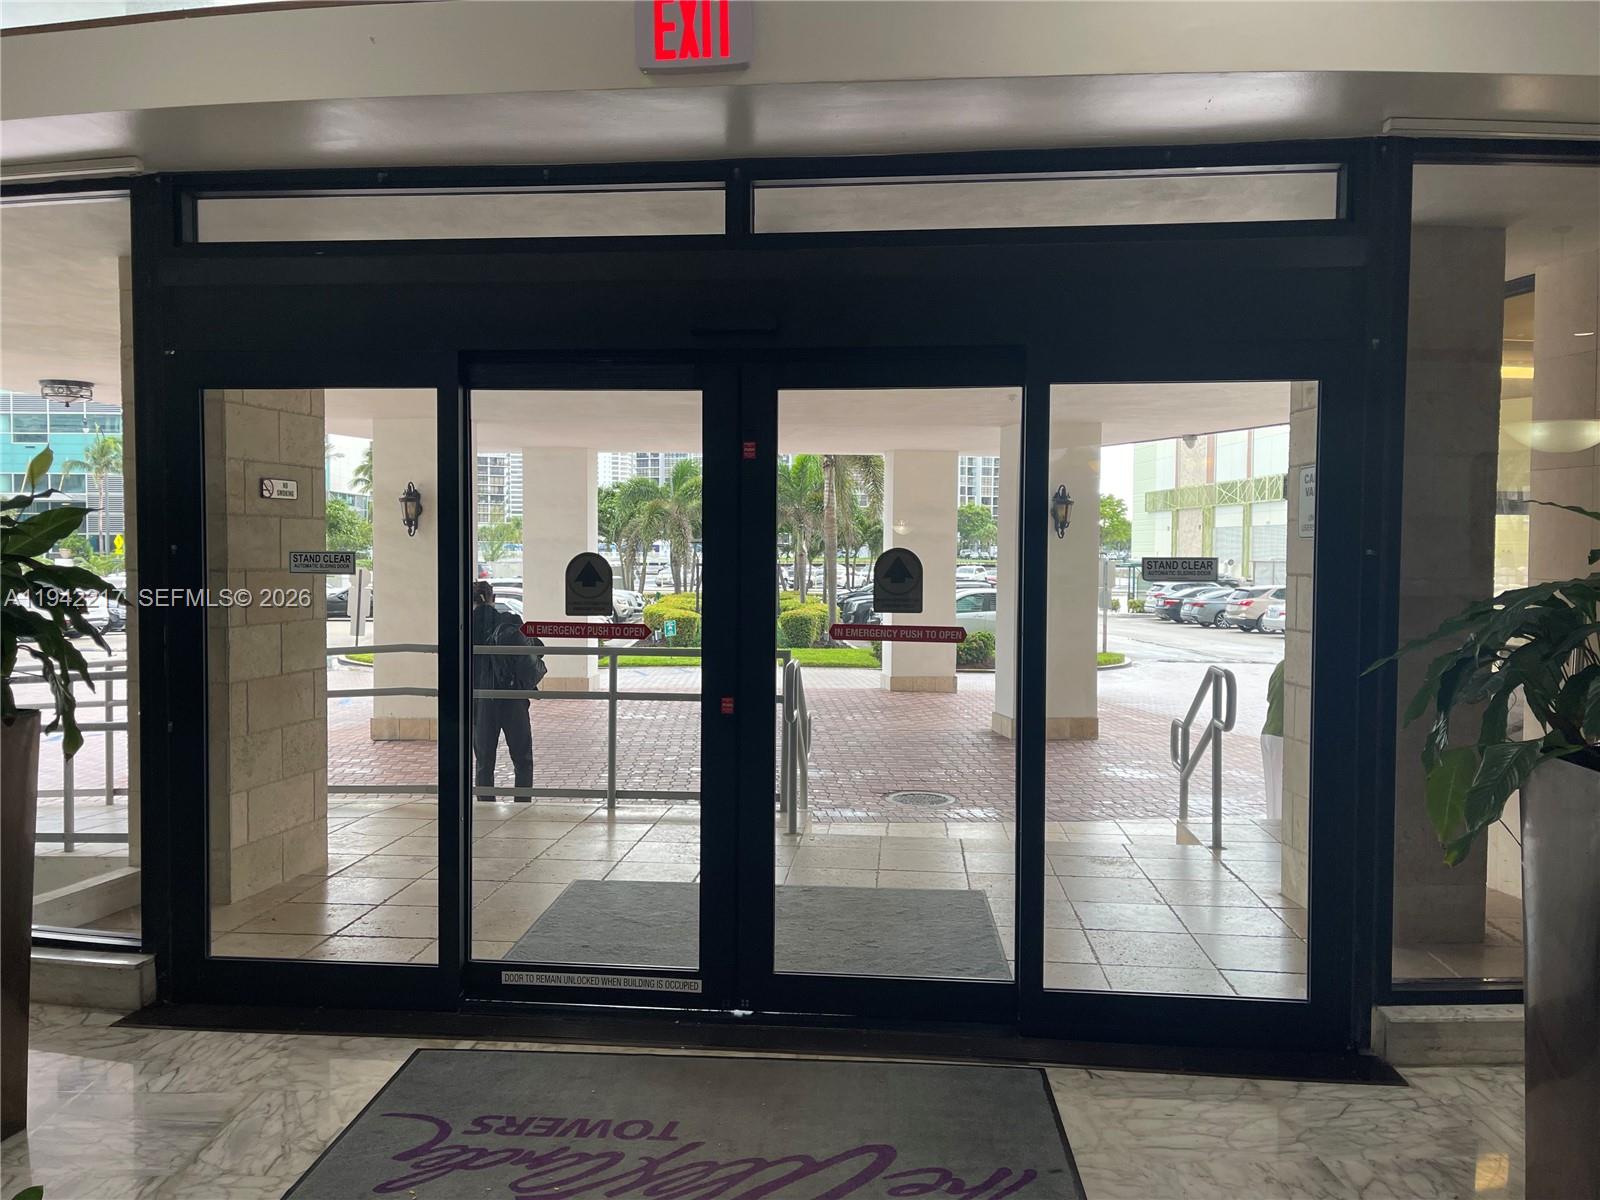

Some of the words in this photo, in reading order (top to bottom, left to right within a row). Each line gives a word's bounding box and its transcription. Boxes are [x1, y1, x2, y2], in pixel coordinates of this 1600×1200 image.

[653, 0, 731, 60] EXIT
[292, 554, 321, 563] STAND
[323, 554, 351, 563] CLEAR
[1146, 560, 1179, 570] STAND
[1181, 560, 1213, 570] CLEAR
[526, 625, 535, 634] IN
[536, 625, 587, 636] EMERGENCY
[587, 626, 609, 636] PUSH
[611, 626, 621, 636] TO
[622, 627, 645, 637] OPEN
[834, 628, 843, 636] IN
[845, 628, 898, 638] EMERGENCY
[900, 629, 923, 639] PUSH
[925, 630, 937, 639] TO
[939, 630, 962, 640] OPEN
[504, 973, 524, 983] DOOR
[525, 974, 535, 983] TO
[536, 974, 562, 984] REMAIN
[563, 975, 600, 986] UNLOCKED
[601, 977, 622, 987] WHEN
[623, 978, 655, 988] BUILDING
[656, 979, 664, 989] IS
[664, 980, 699, 991] OCCUPIED
[461, 1114, 681, 1142] TOWERS
